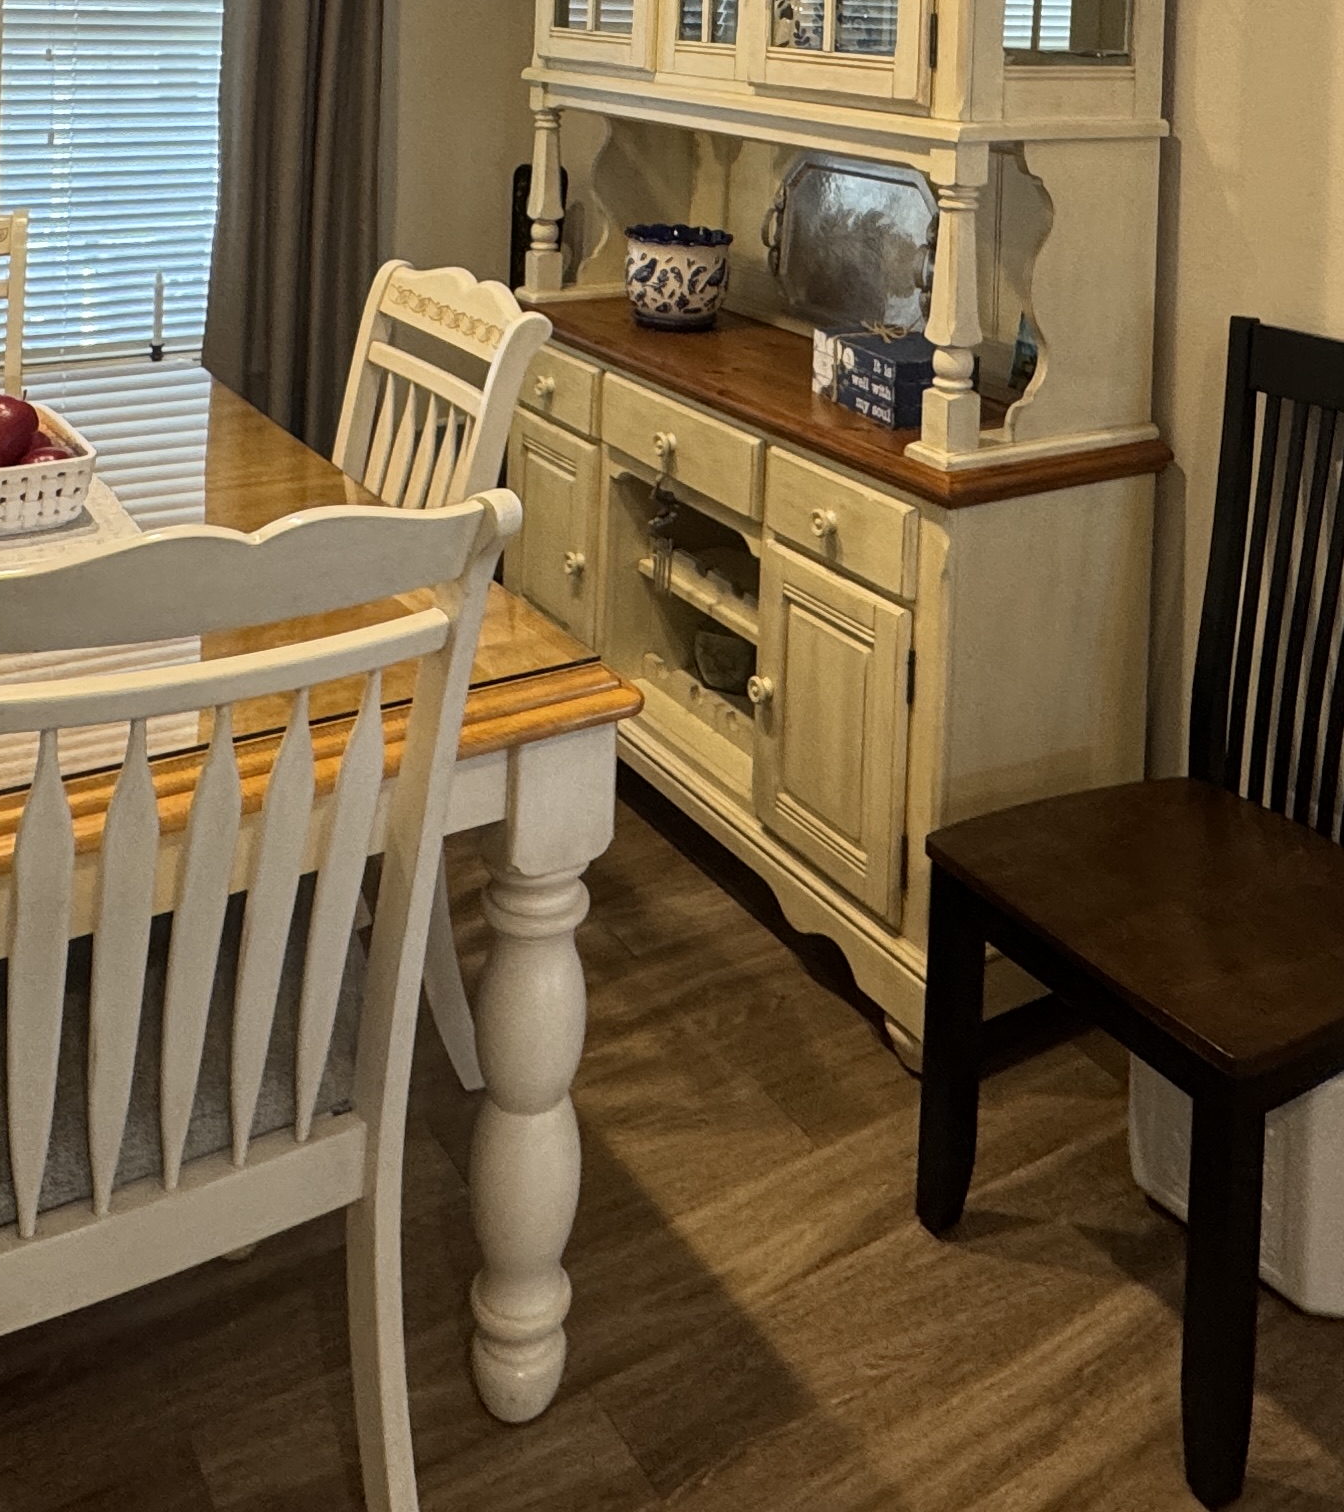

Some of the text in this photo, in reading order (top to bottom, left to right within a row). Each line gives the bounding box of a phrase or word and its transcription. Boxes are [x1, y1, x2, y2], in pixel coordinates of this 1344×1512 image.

[872, 358, 893, 378] It is
[851, 373, 892, 401] well with
[855, 396, 892, 424] my soul
